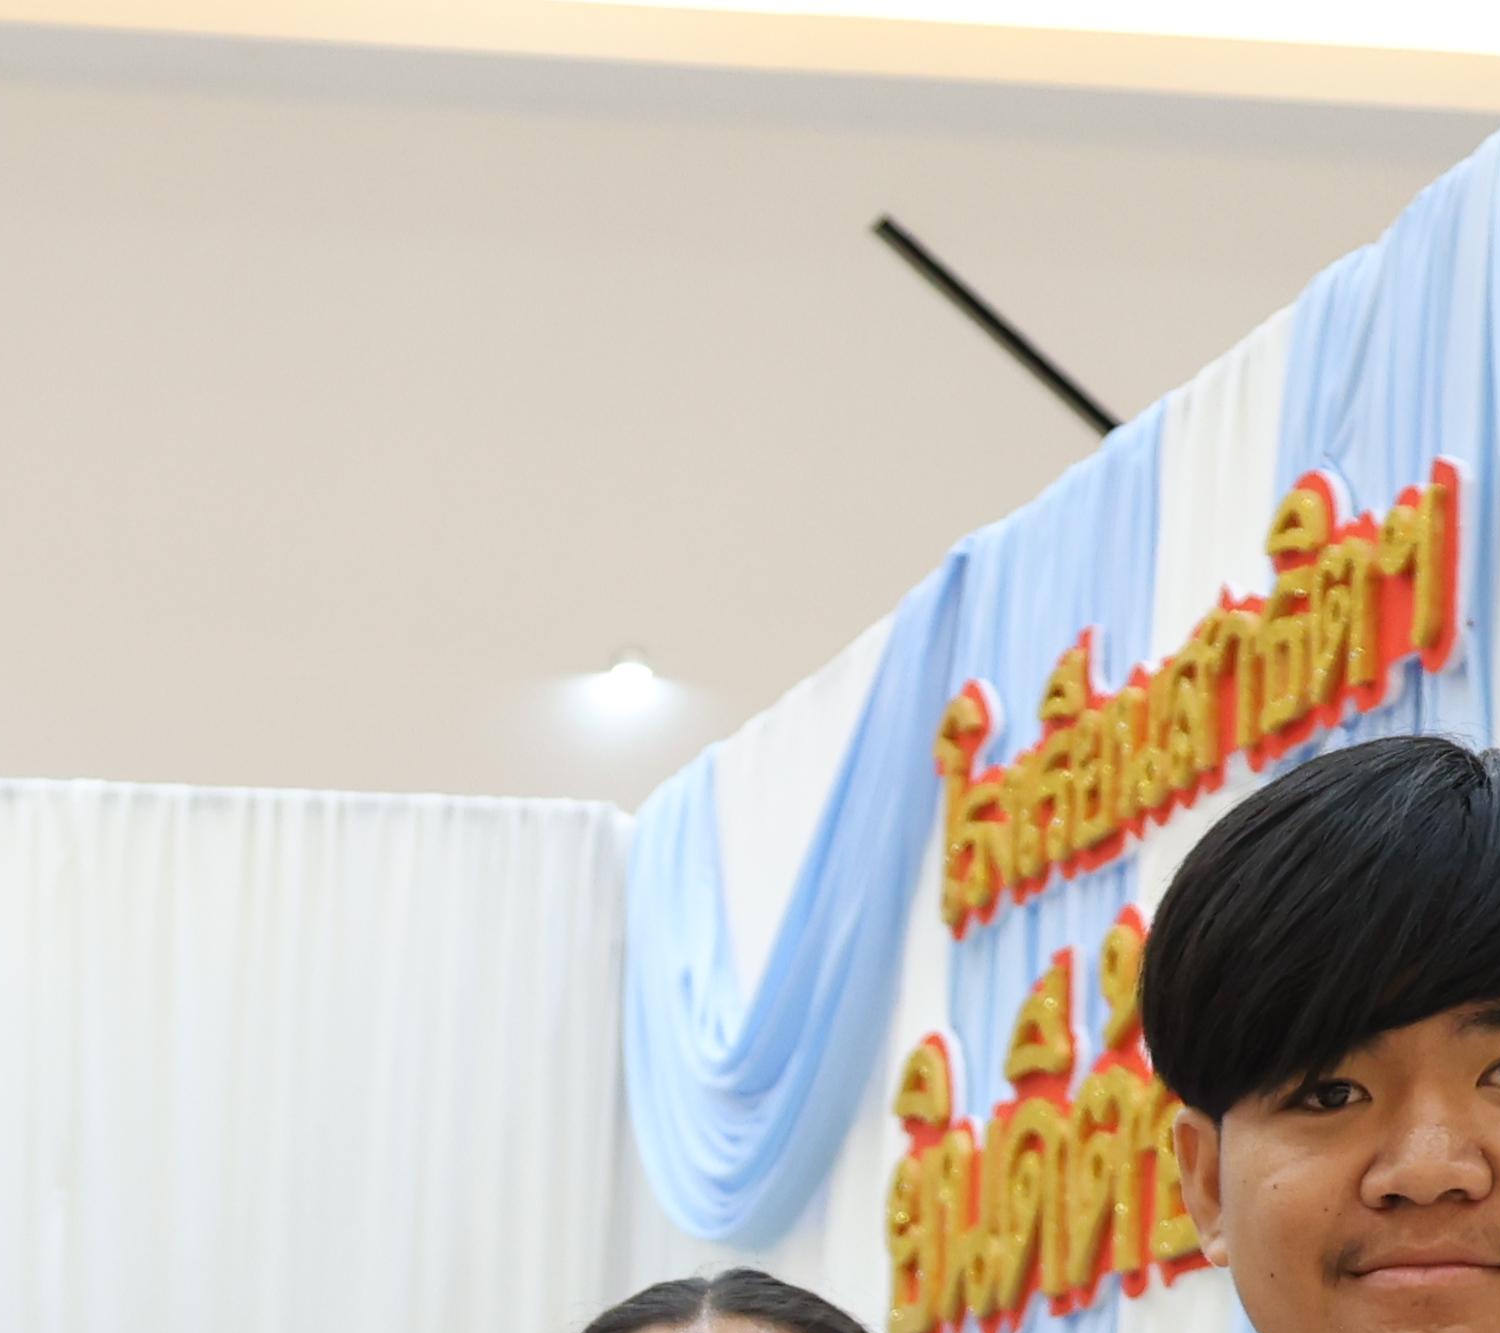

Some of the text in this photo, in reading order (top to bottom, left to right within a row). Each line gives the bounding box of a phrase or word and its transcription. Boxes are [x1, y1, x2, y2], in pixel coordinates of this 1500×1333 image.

[933, 456, 1463, 939] โรงเรียนสาธิตฯ
